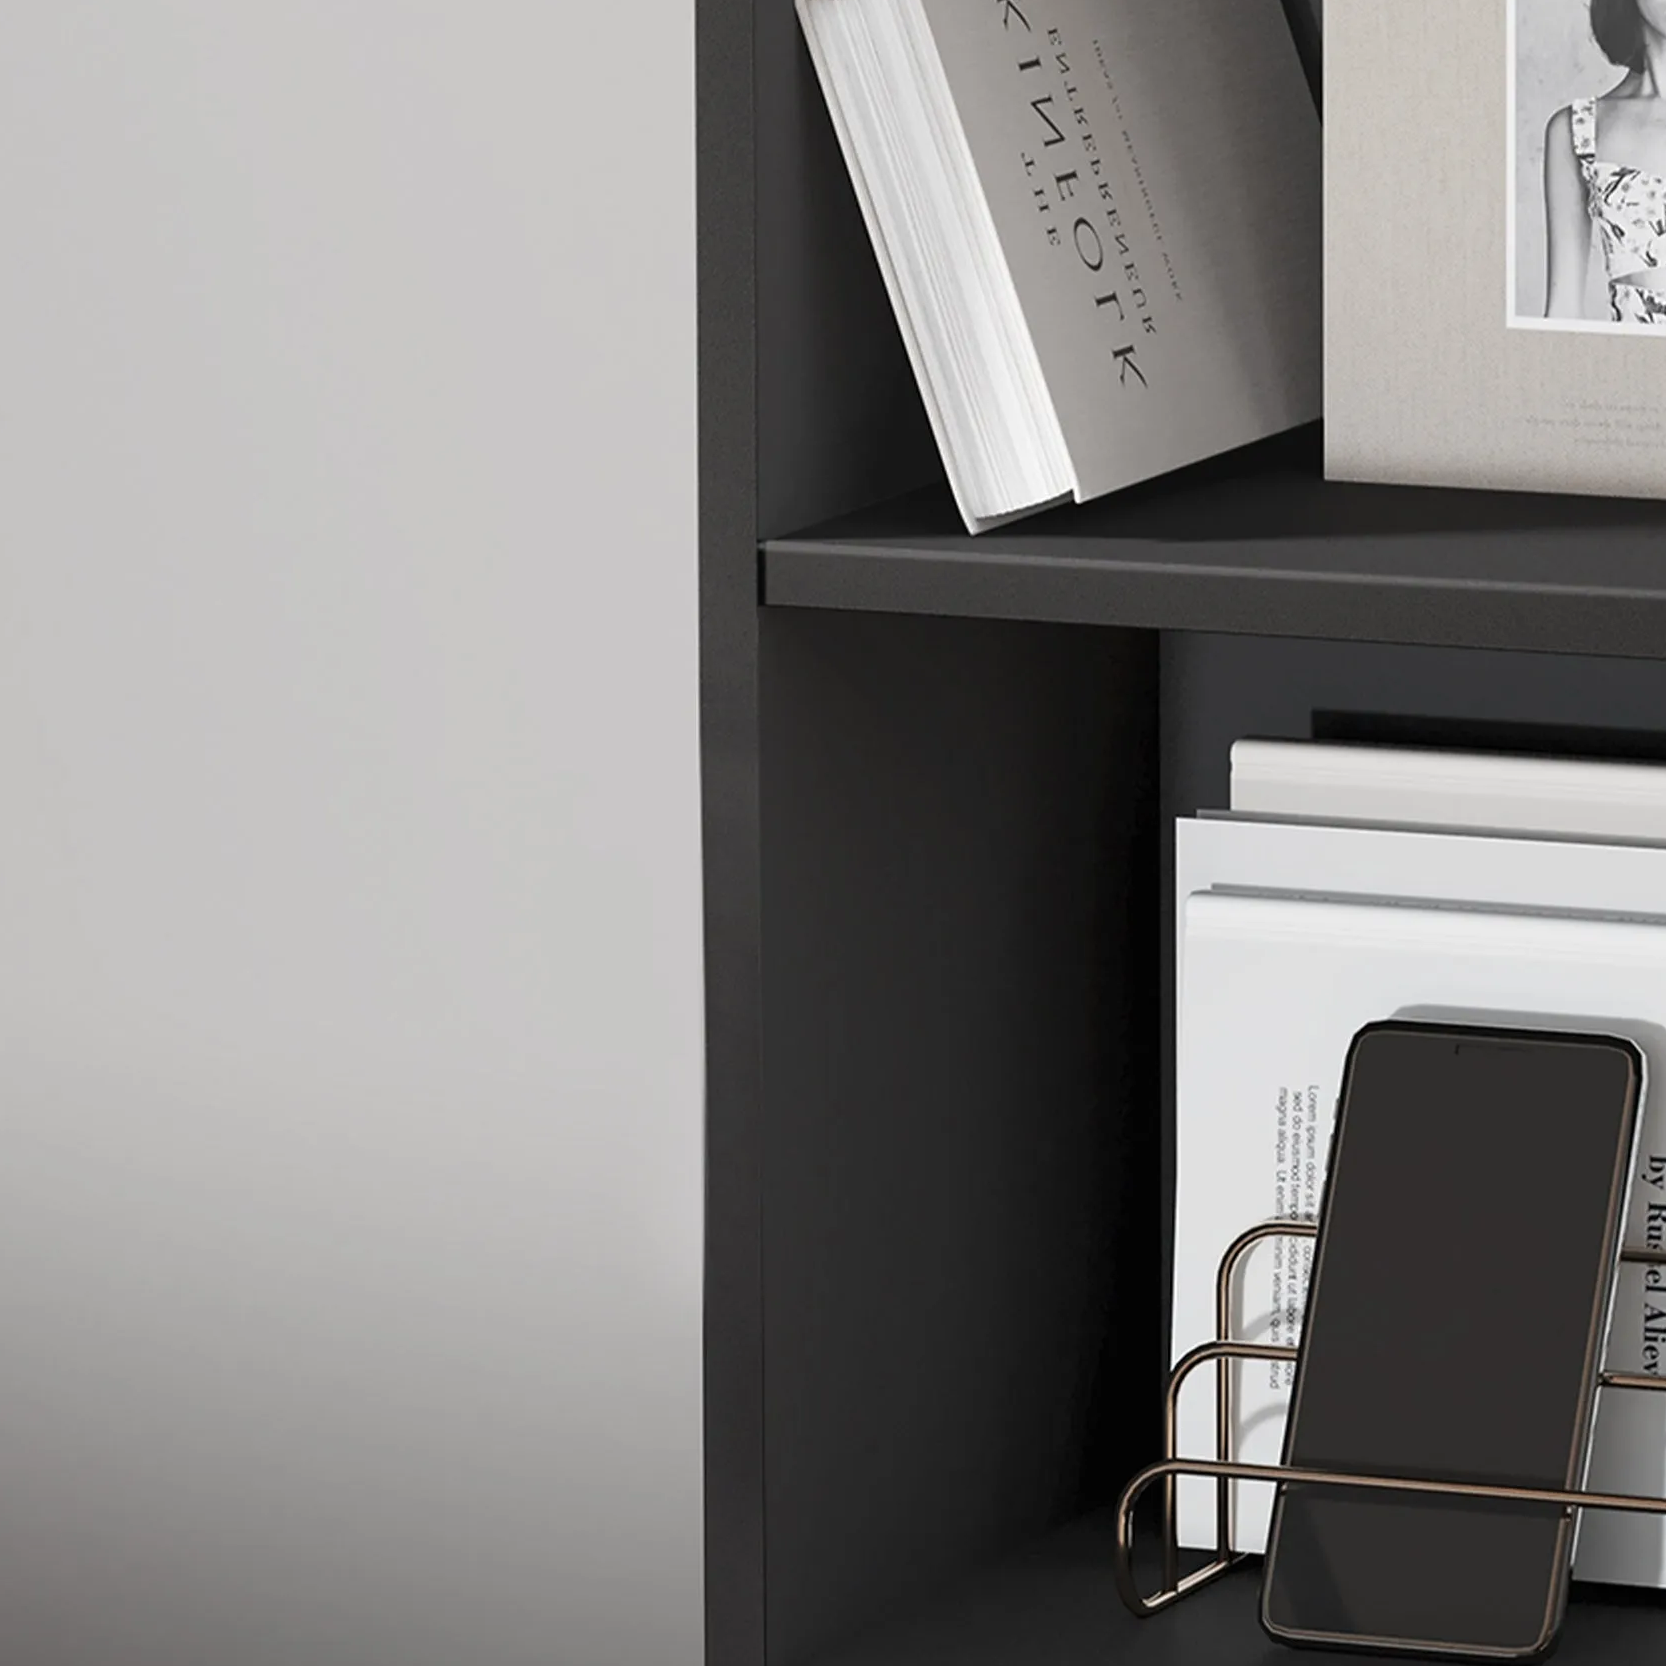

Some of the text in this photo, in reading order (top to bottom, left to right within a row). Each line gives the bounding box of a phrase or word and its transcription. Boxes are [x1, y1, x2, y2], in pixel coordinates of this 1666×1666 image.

[1292, 1091, 1303, 1113] sed
[1307, 1085, 1320, 1123] Lorem
[1292, 1114, 1303, 1131] do
[1305, 1161, 1316, 1191] dolor
[1289, 1183, 1300, 1221] tempo
